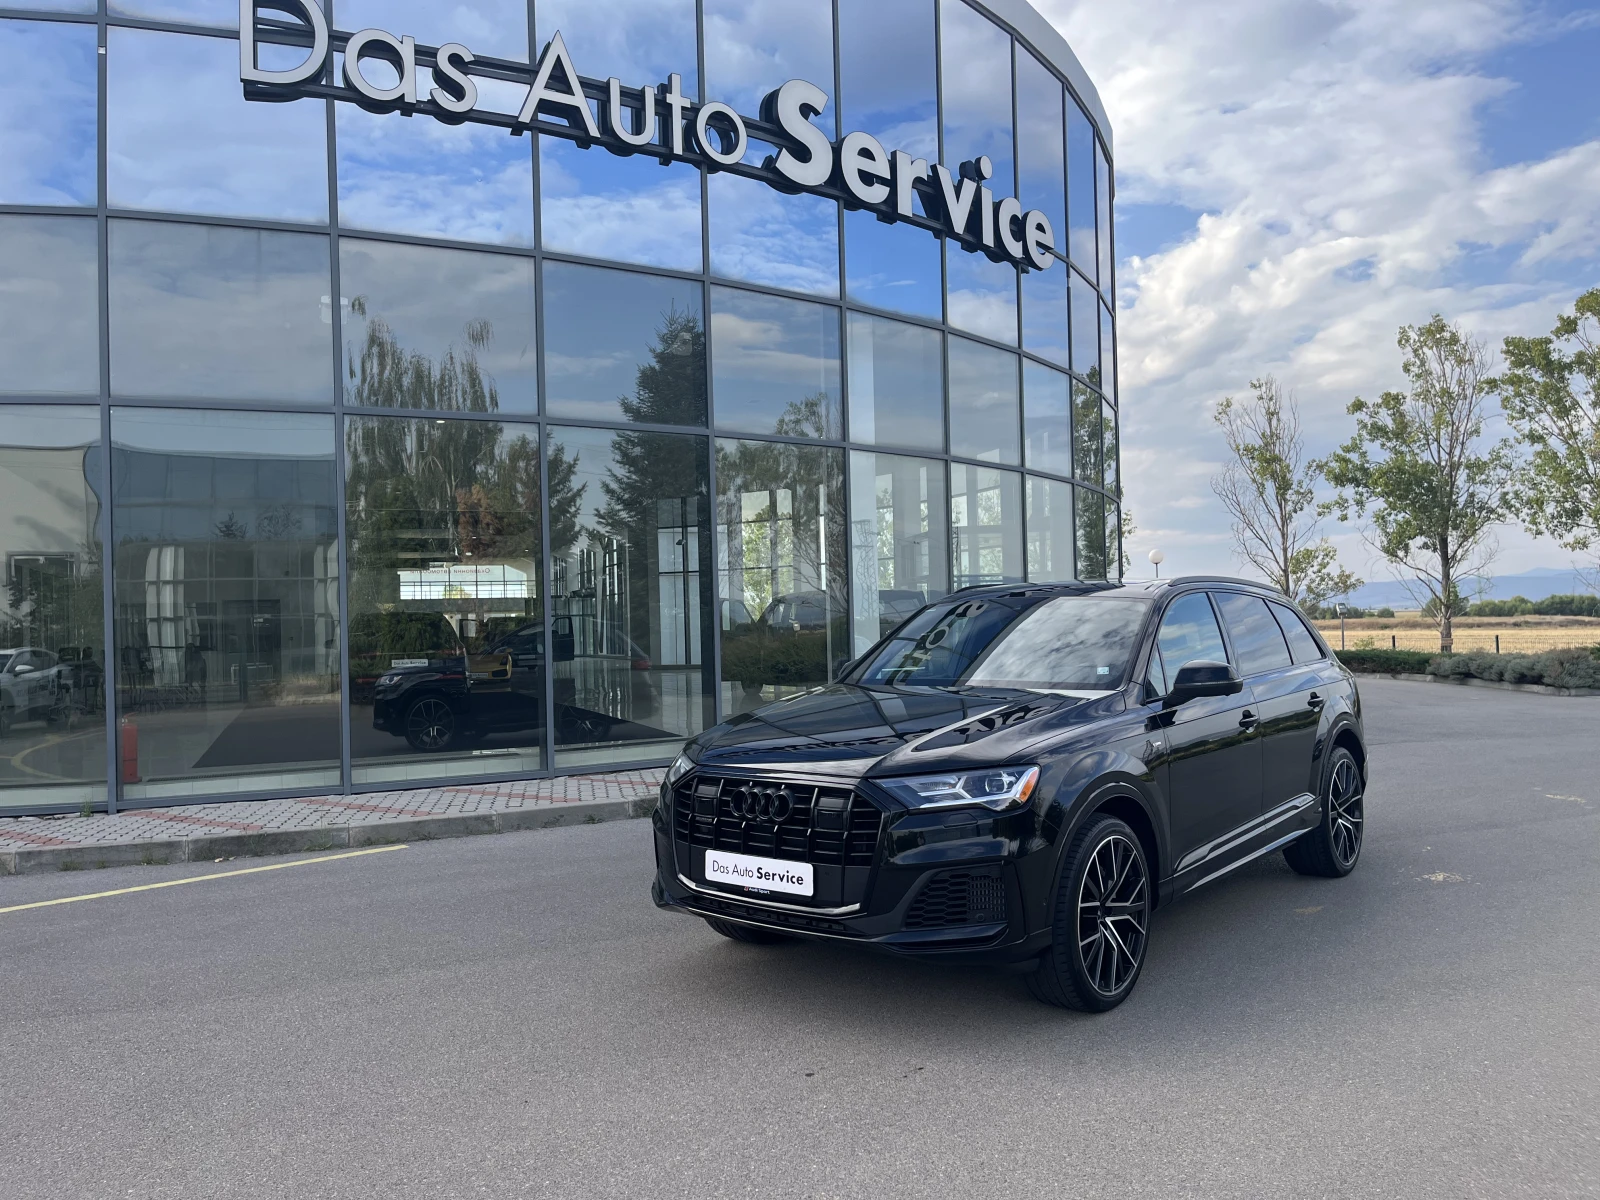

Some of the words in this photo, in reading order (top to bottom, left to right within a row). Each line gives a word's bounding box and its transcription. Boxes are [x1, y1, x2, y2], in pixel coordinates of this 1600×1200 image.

[239, 0, 478, 114] Das
[517, 29, 748, 166] Auto
[774, 78, 1055, 271] Service
[712, 859, 730, 875] Das
[732, 863, 754, 878] Auto
[756, 866, 804, 886] Service
